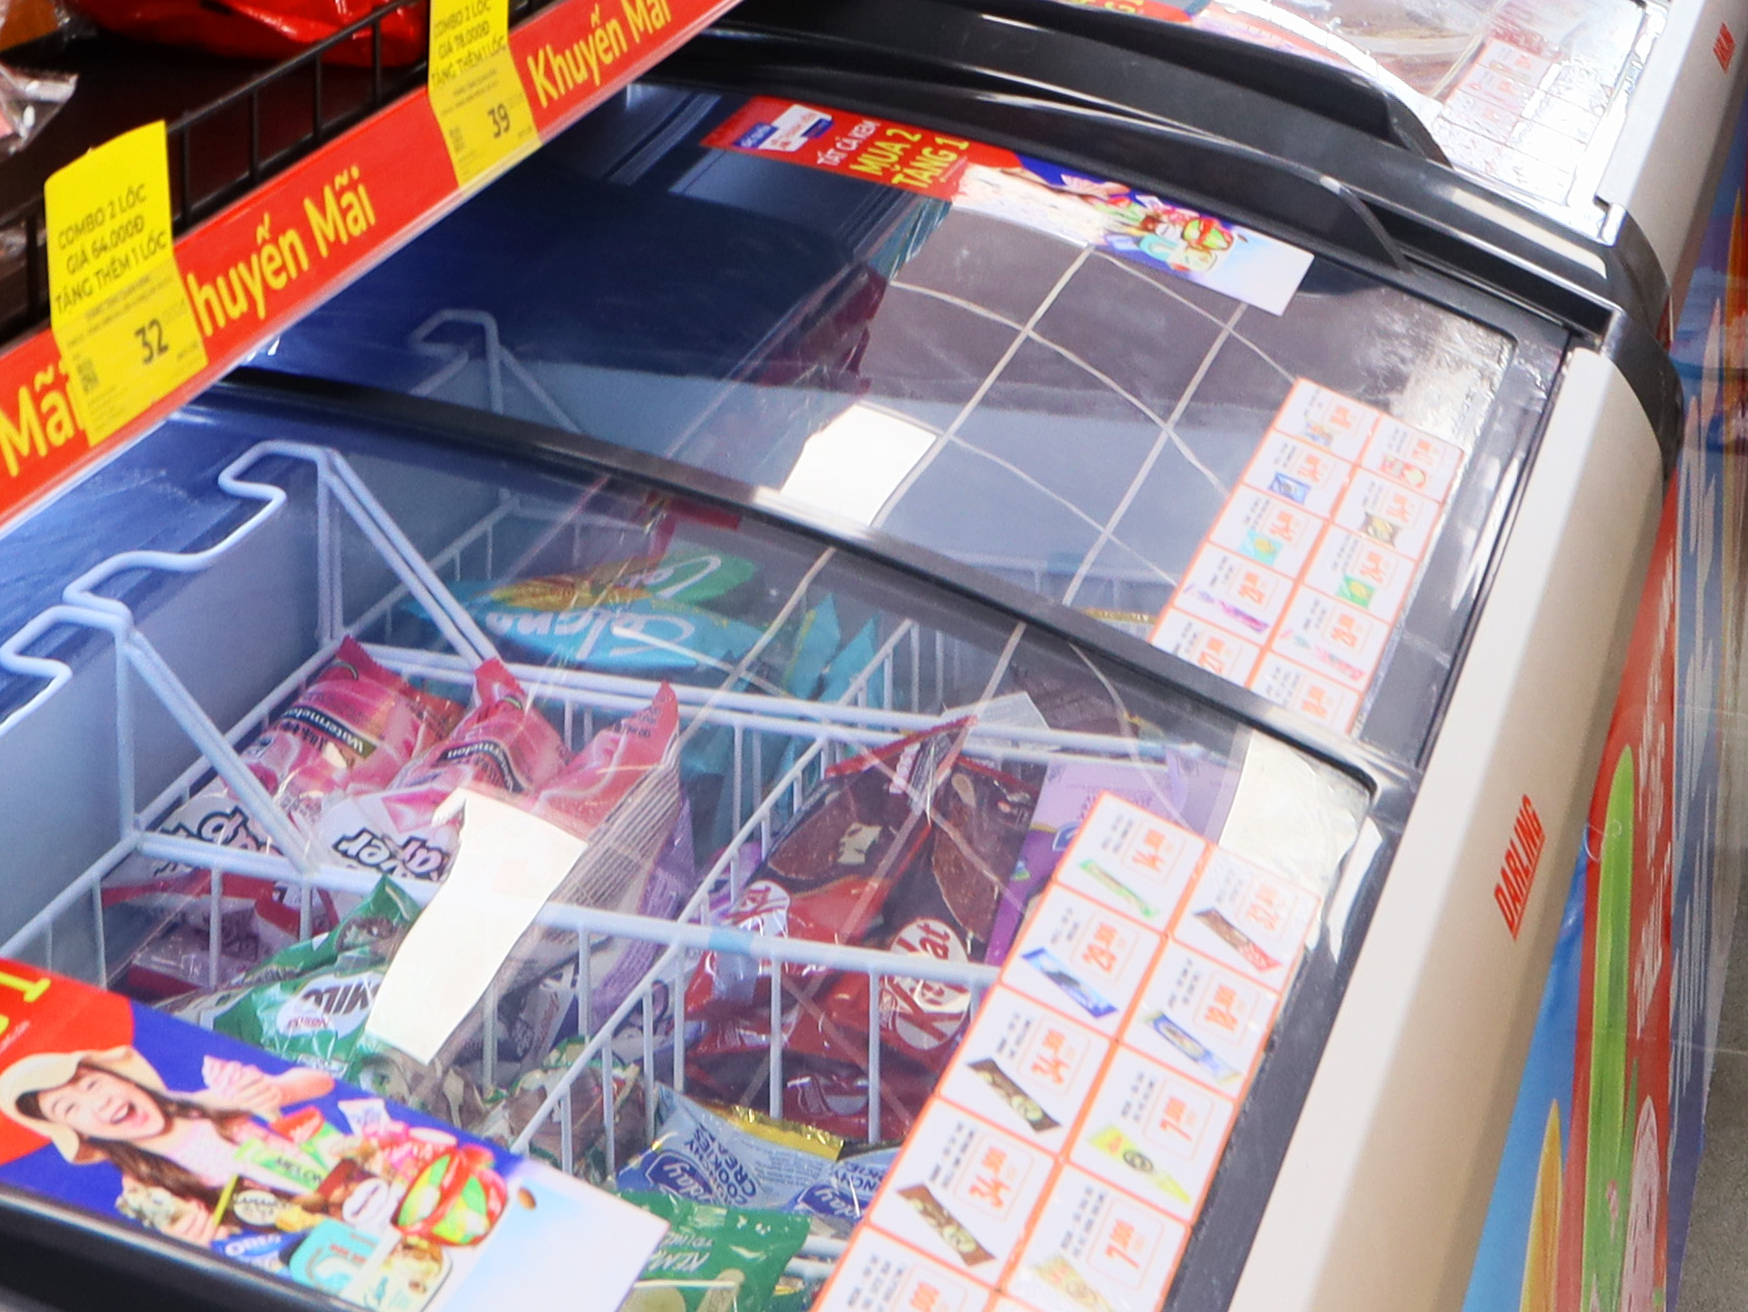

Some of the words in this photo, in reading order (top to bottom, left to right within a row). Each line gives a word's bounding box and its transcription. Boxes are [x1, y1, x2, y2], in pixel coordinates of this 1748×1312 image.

[526, 2, 628, 109] Khuyến
[486, 103, 512, 140] 39
[934, 136, 971, 151] 1
[849, 140, 904, 176] MUA
[885, 128, 923, 142] 2
[56, 205, 106, 251] COMBO
[107, 199, 117, 217] 2
[118, 182, 148, 214] LỐC
[66, 245, 90, 277] GIÁ
[94, 255, 133, 291] THÊM
[139, 230, 168, 262] LỐC
[186, 212, 311, 337] huyến
[303, 165, 377, 258] Mãi
[133, 317, 170, 366] 32
[1493, 793, 1546, 937] DARLING
